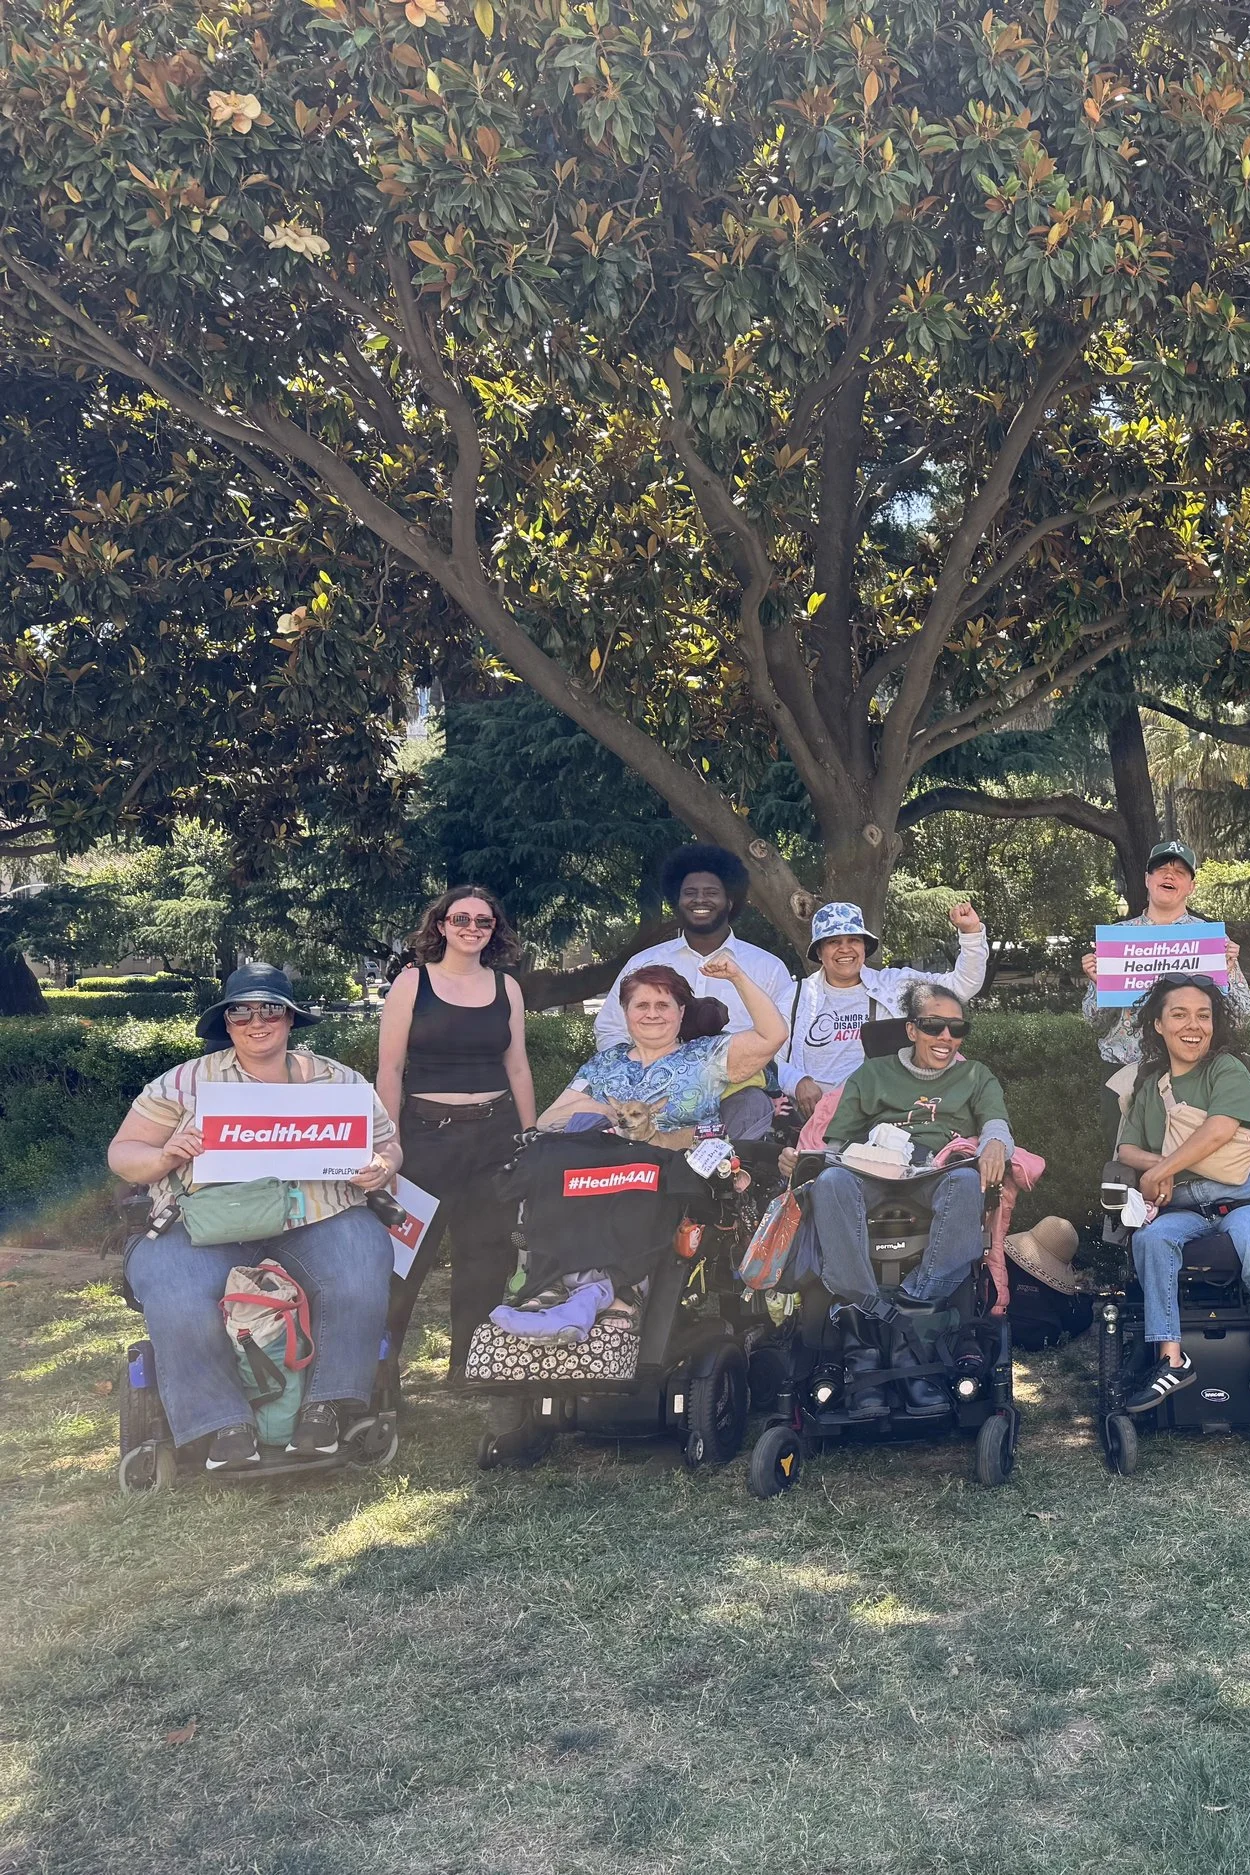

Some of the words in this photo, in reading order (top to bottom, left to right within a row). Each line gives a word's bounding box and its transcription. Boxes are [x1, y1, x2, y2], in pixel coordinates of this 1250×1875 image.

[1124, 941, 1200, 956] Health4All
[1124, 957, 1200, 972] Health4All
[833, 1029, 863, 1041] ACTI
[219, 1122, 352, 1143] Health4All
[568, 1170, 655, 1190] #Health4All
